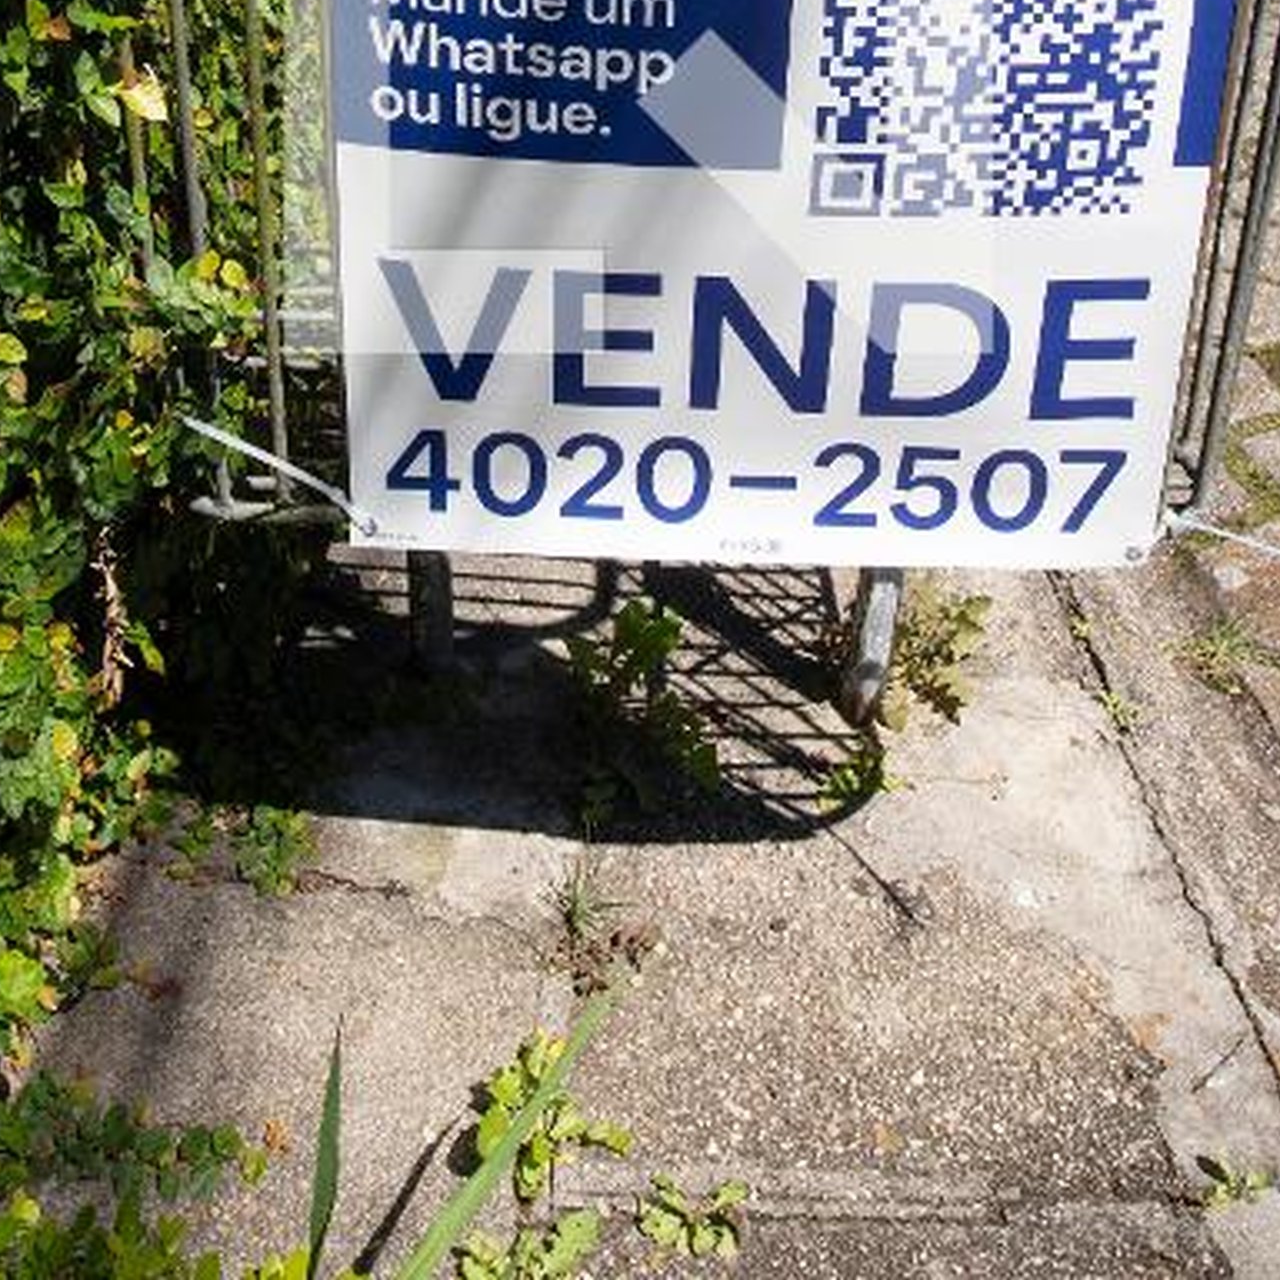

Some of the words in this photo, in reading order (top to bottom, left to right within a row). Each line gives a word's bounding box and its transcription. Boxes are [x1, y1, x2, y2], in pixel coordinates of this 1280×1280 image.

[370, 19, 677, 94] Whatsapp
[370, 86, 441, 125] ou
[457, 84, 612, 141] ligue.
[377, 259, 1152, 421] VENDE
[385, 428, 1127, 534] 4020-2507
